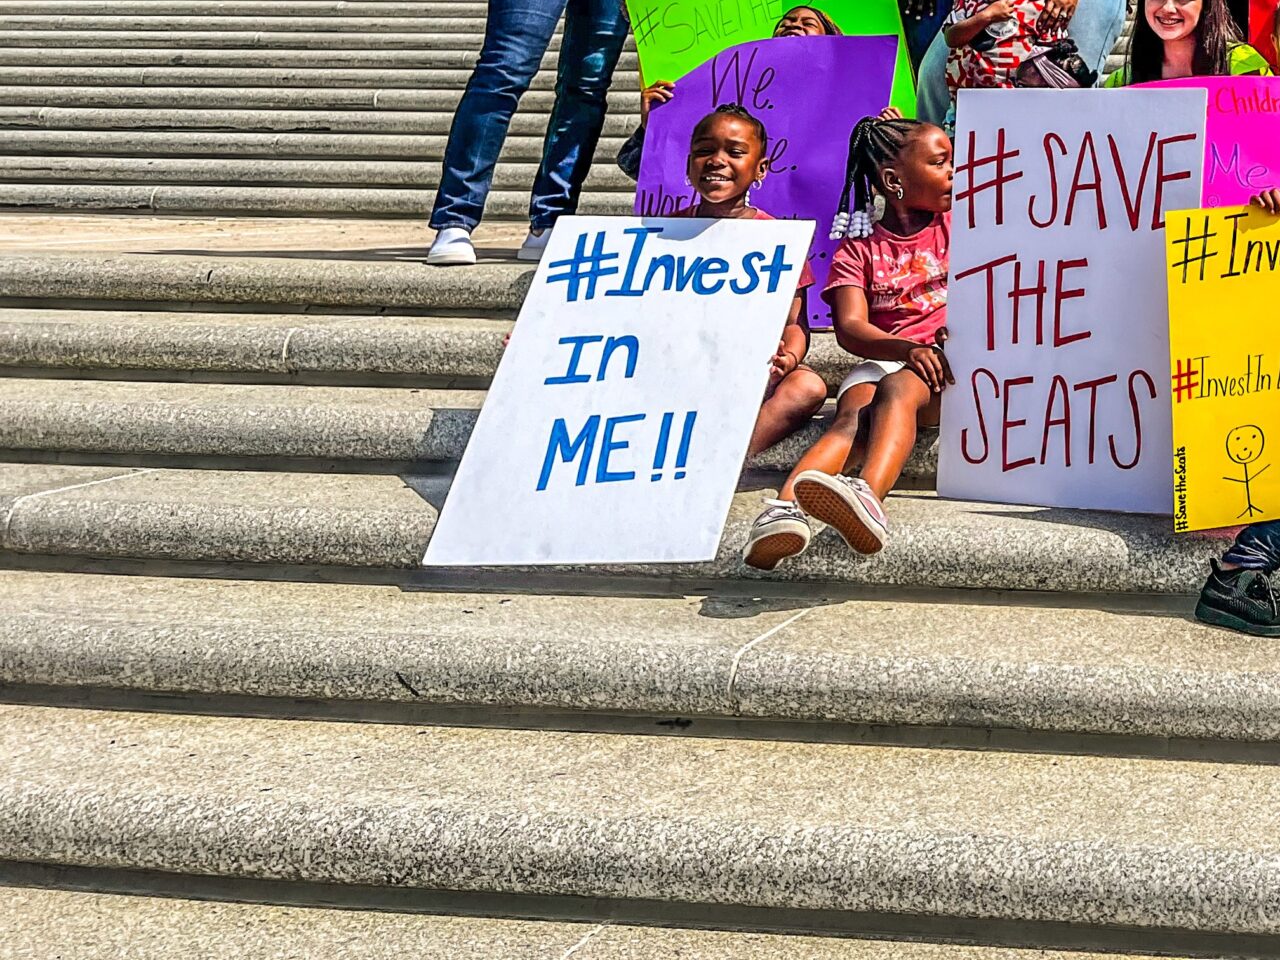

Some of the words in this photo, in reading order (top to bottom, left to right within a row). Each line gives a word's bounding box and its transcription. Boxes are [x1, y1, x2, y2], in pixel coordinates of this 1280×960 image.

[955, 128, 1197, 231] #SAVE
[546, 226, 793, 302] #Invest
[954, 254, 1092, 351] THE
[544, 334, 639, 385] In
[536, 410, 697, 491] ME!!
[961, 368, 1157, 472] SEATS
